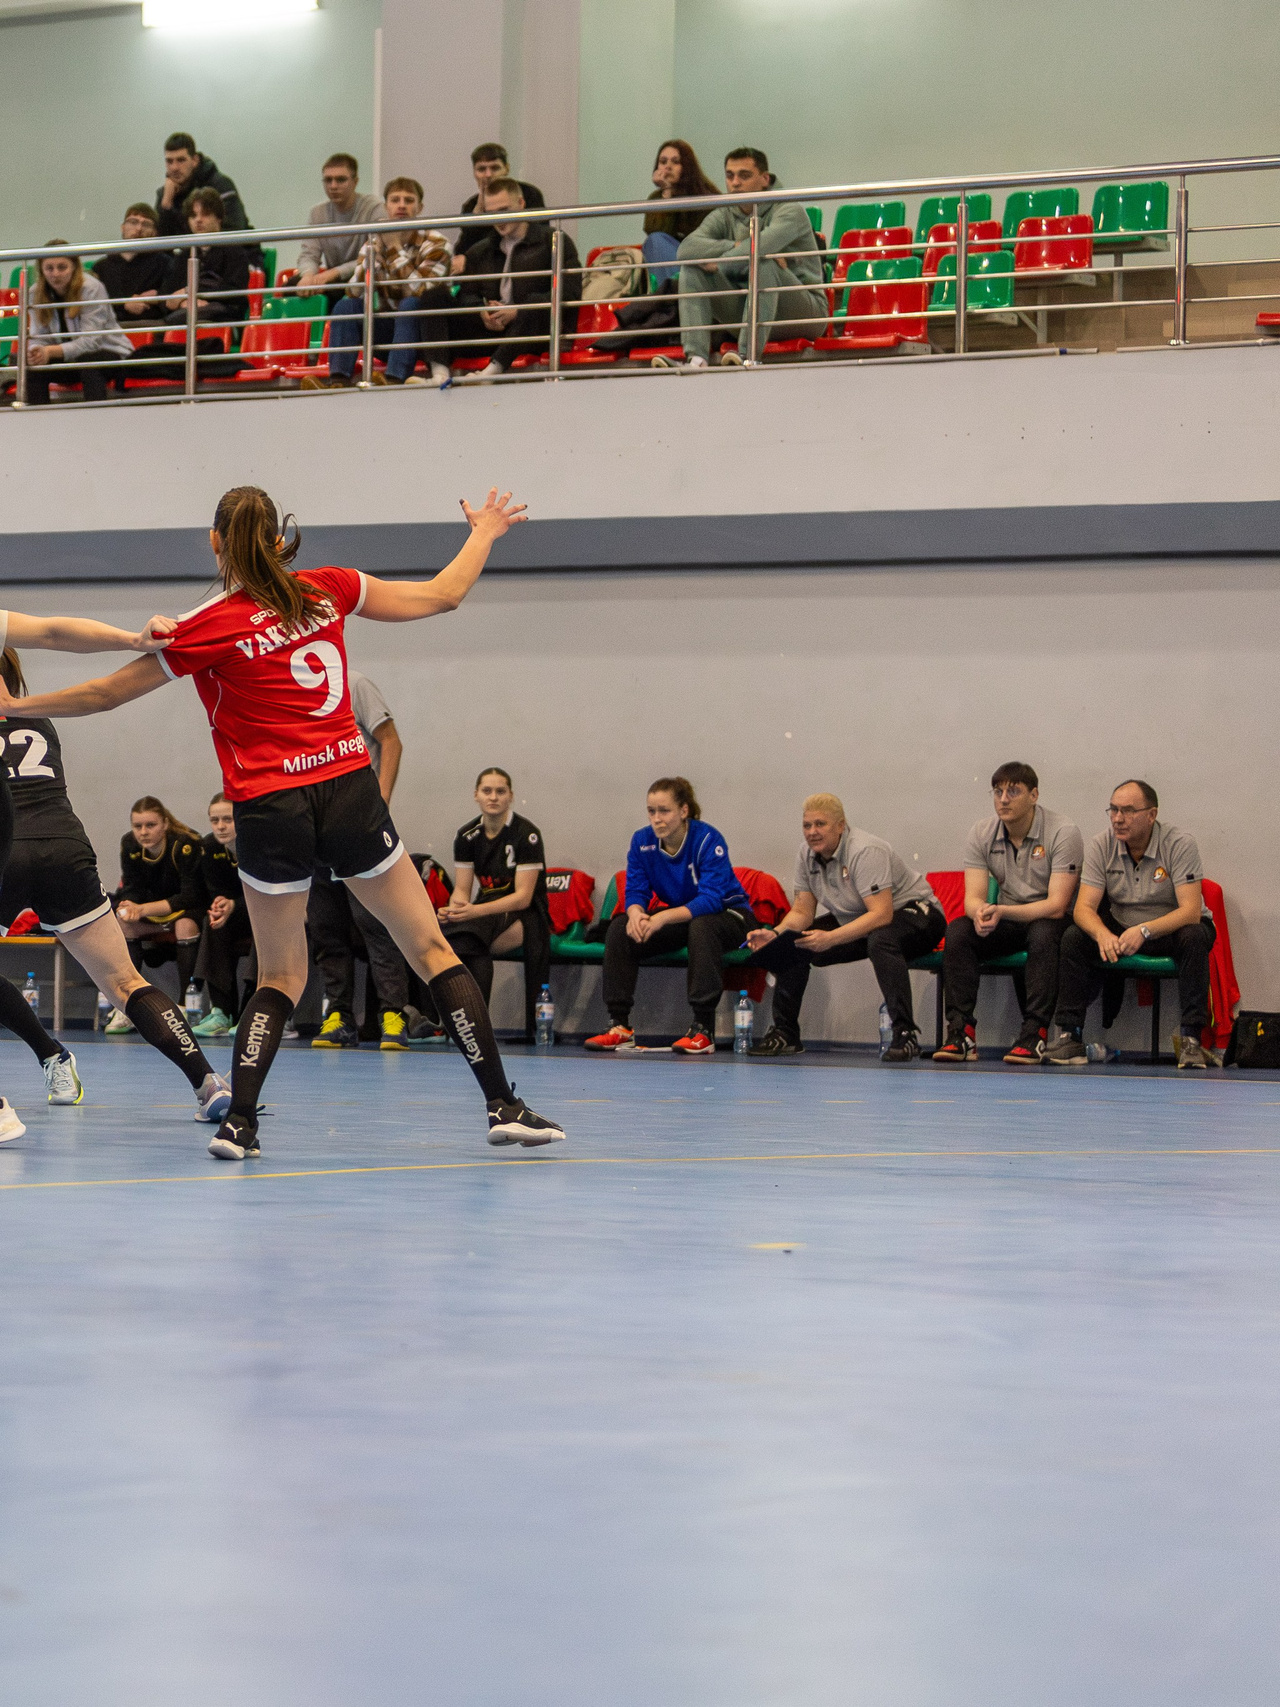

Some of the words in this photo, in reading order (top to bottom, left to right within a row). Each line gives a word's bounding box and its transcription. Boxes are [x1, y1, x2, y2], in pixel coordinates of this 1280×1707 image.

[290, 640, 344, 717] 9
[283, 744, 336, 774] Minsk
[504, 844, 517, 869] 2
[688, 863, 699, 886] 1
[161, 1008, 198, 1056] Kempa
[239, 1012, 271, 1067] Kempa
[450, 1007, 484, 1065] Kempa
